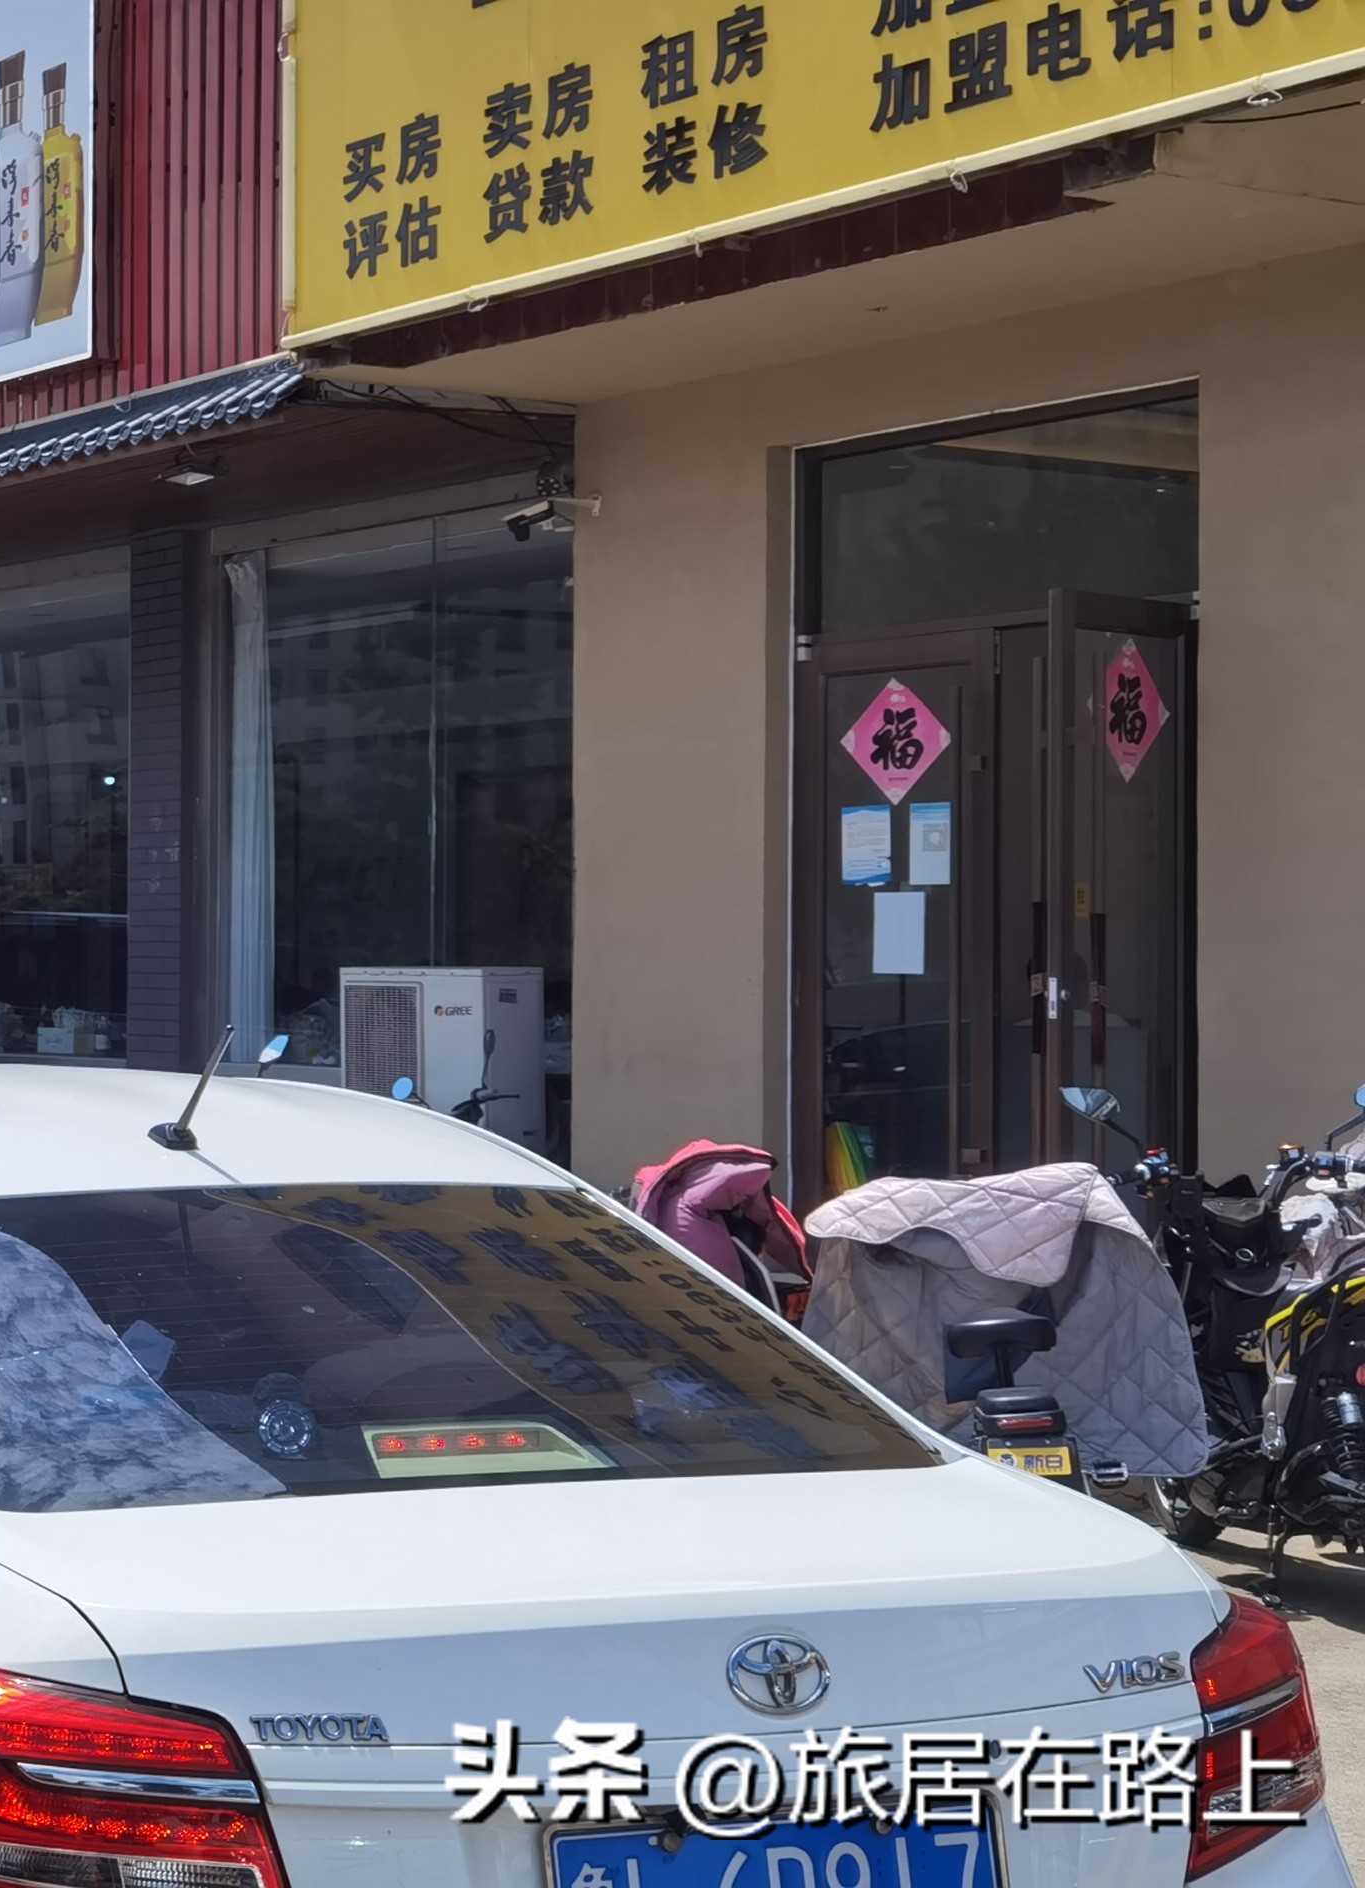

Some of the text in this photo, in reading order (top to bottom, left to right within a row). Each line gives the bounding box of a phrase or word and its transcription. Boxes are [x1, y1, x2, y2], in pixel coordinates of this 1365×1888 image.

[343, 4, 768, 203] 买房 卖房 租房
[343, 102, 769, 280] 评估 贷款 装修
[870, 708, 924, 771] 福
[1109, 673, 1147, 746] 福
[444, 1005, 473, 1016] GREE
[1083, 1651, 1186, 1693] VIOS
[250, 1713, 389, 1741] TOYOTA
